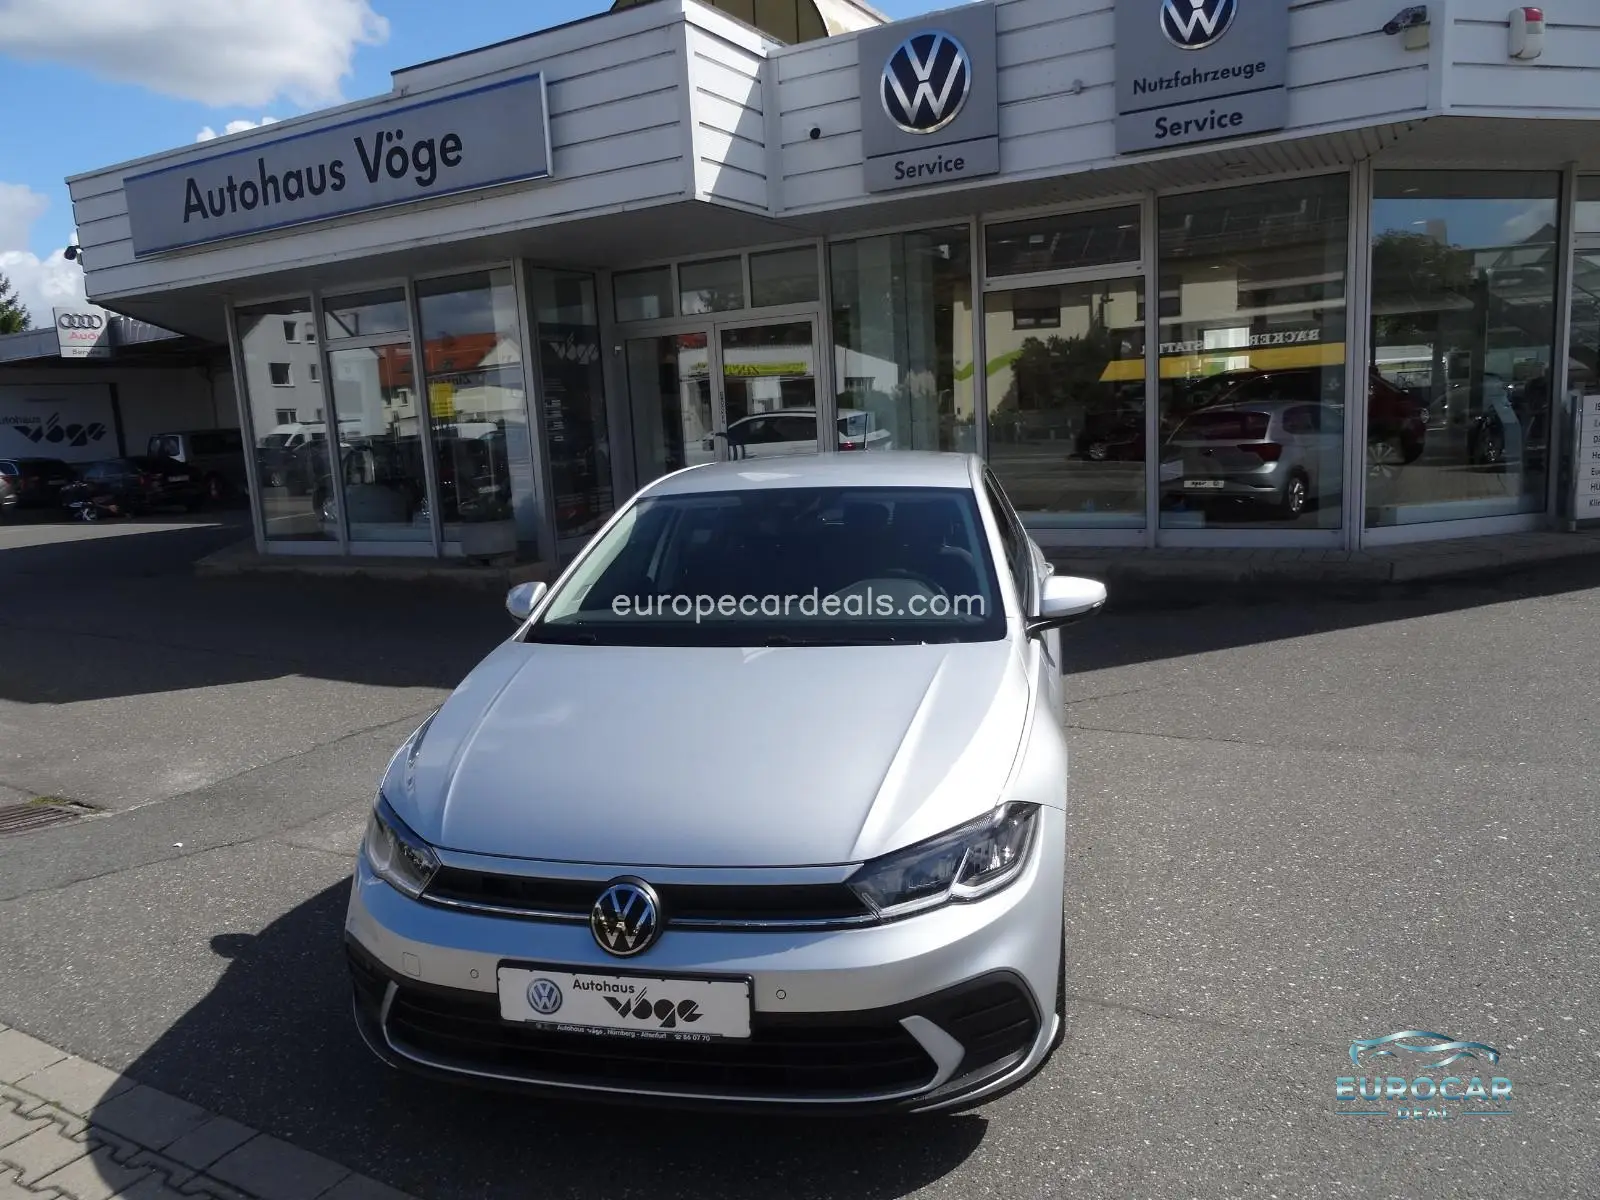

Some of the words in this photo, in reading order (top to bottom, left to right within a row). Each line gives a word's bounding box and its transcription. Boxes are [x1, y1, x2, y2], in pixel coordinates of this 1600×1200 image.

[1133, 59, 1266, 95] Nutzfahrzeuge
[1154, 108, 1243, 140] Service
[183, 157, 345, 222] Autohaus
[354, 129, 463, 188] Vöge
[894, 155, 965, 181] Service
[572, 979, 635, 994] Autohaus
[557, 1024, 584, 1034] Autohaus
